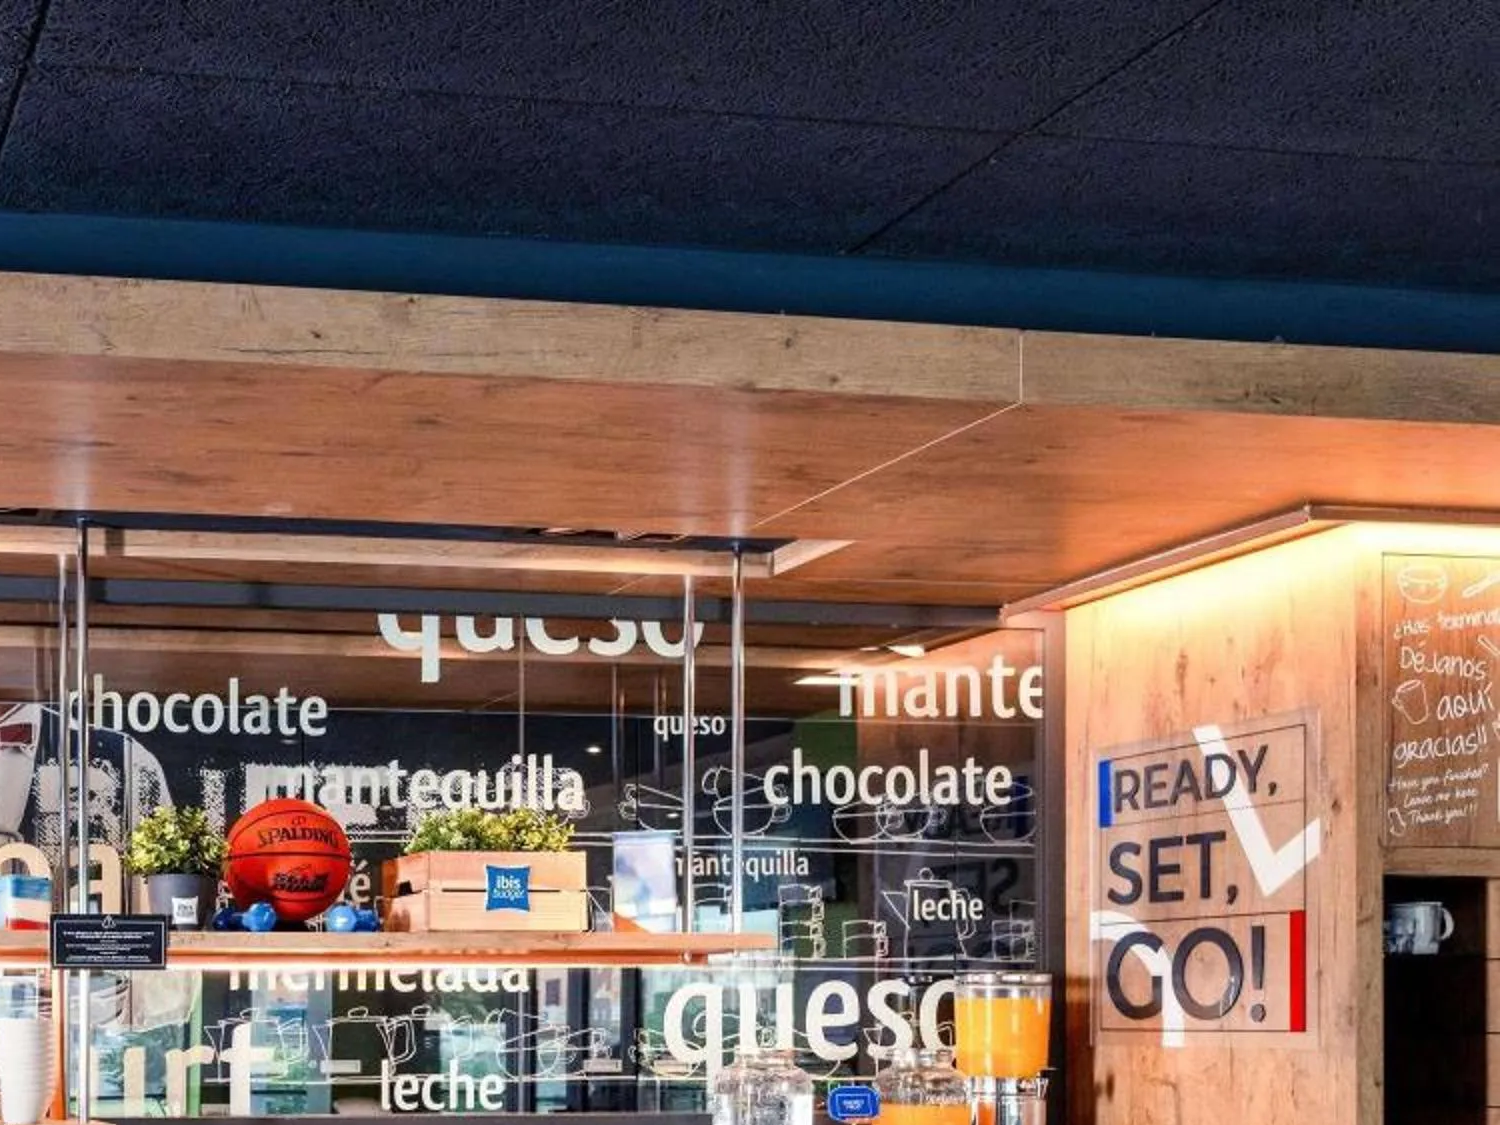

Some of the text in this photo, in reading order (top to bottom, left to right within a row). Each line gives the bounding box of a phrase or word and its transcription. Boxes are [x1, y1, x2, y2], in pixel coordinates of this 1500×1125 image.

[69, 673, 328, 738] chocolate
[763, 748, 1013, 806] chocolate
[1113, 744, 1279, 814] READY,
[257, 826, 339, 850] SPALDING
[676, 848, 809, 882] antquilla
[496, 875, 521, 889] ibis
[1107, 831, 1239, 906] SET,
[913, 889, 984, 921] leche
[1107, 924, 1266, 1024] GO!
[381, 1060, 506, 1111] leche
